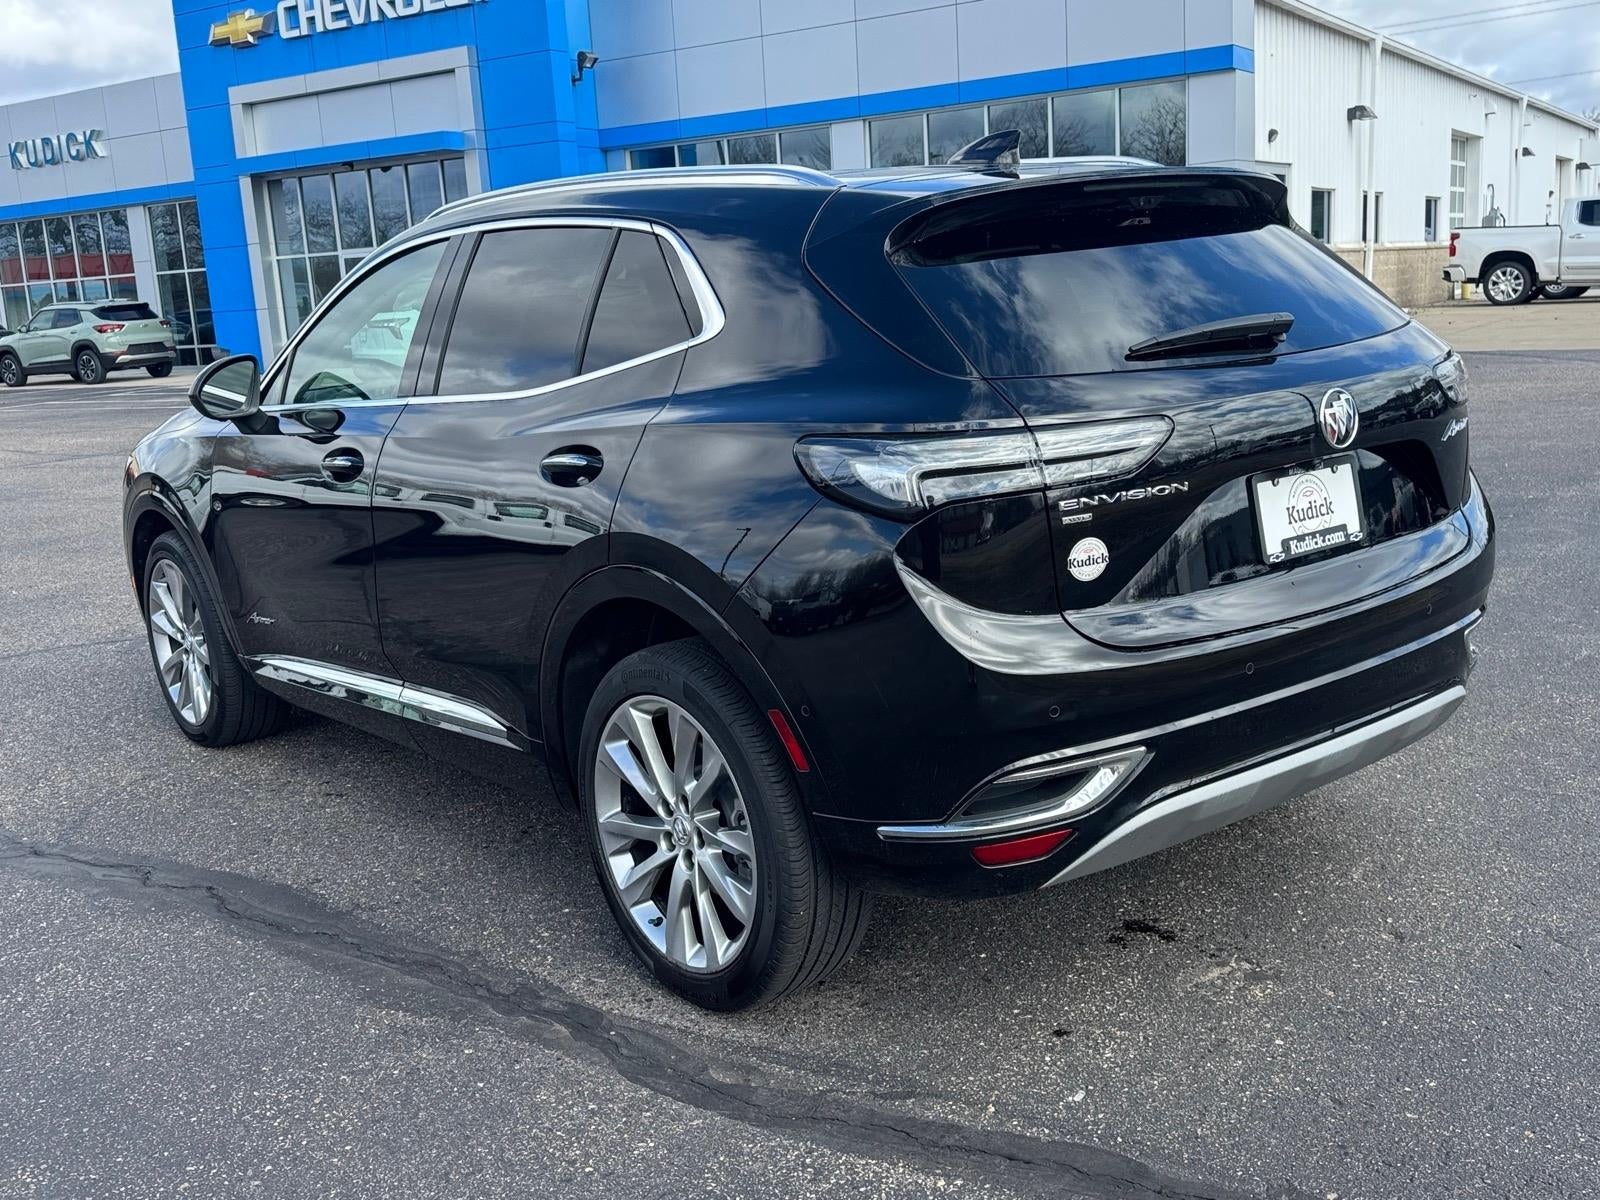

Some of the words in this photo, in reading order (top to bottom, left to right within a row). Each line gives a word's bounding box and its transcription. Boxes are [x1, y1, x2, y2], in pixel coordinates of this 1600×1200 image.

[277, 0, 489, 39] CHEVR
[8, 129, 105, 170] KUDICK
[1058, 481, 1189, 511] ENVISION
[1286, 497, 1334, 525] Kudick
[1289, 531, 1345, 554] Kudick.com
[1069, 553, 1108, 569] Kudick
